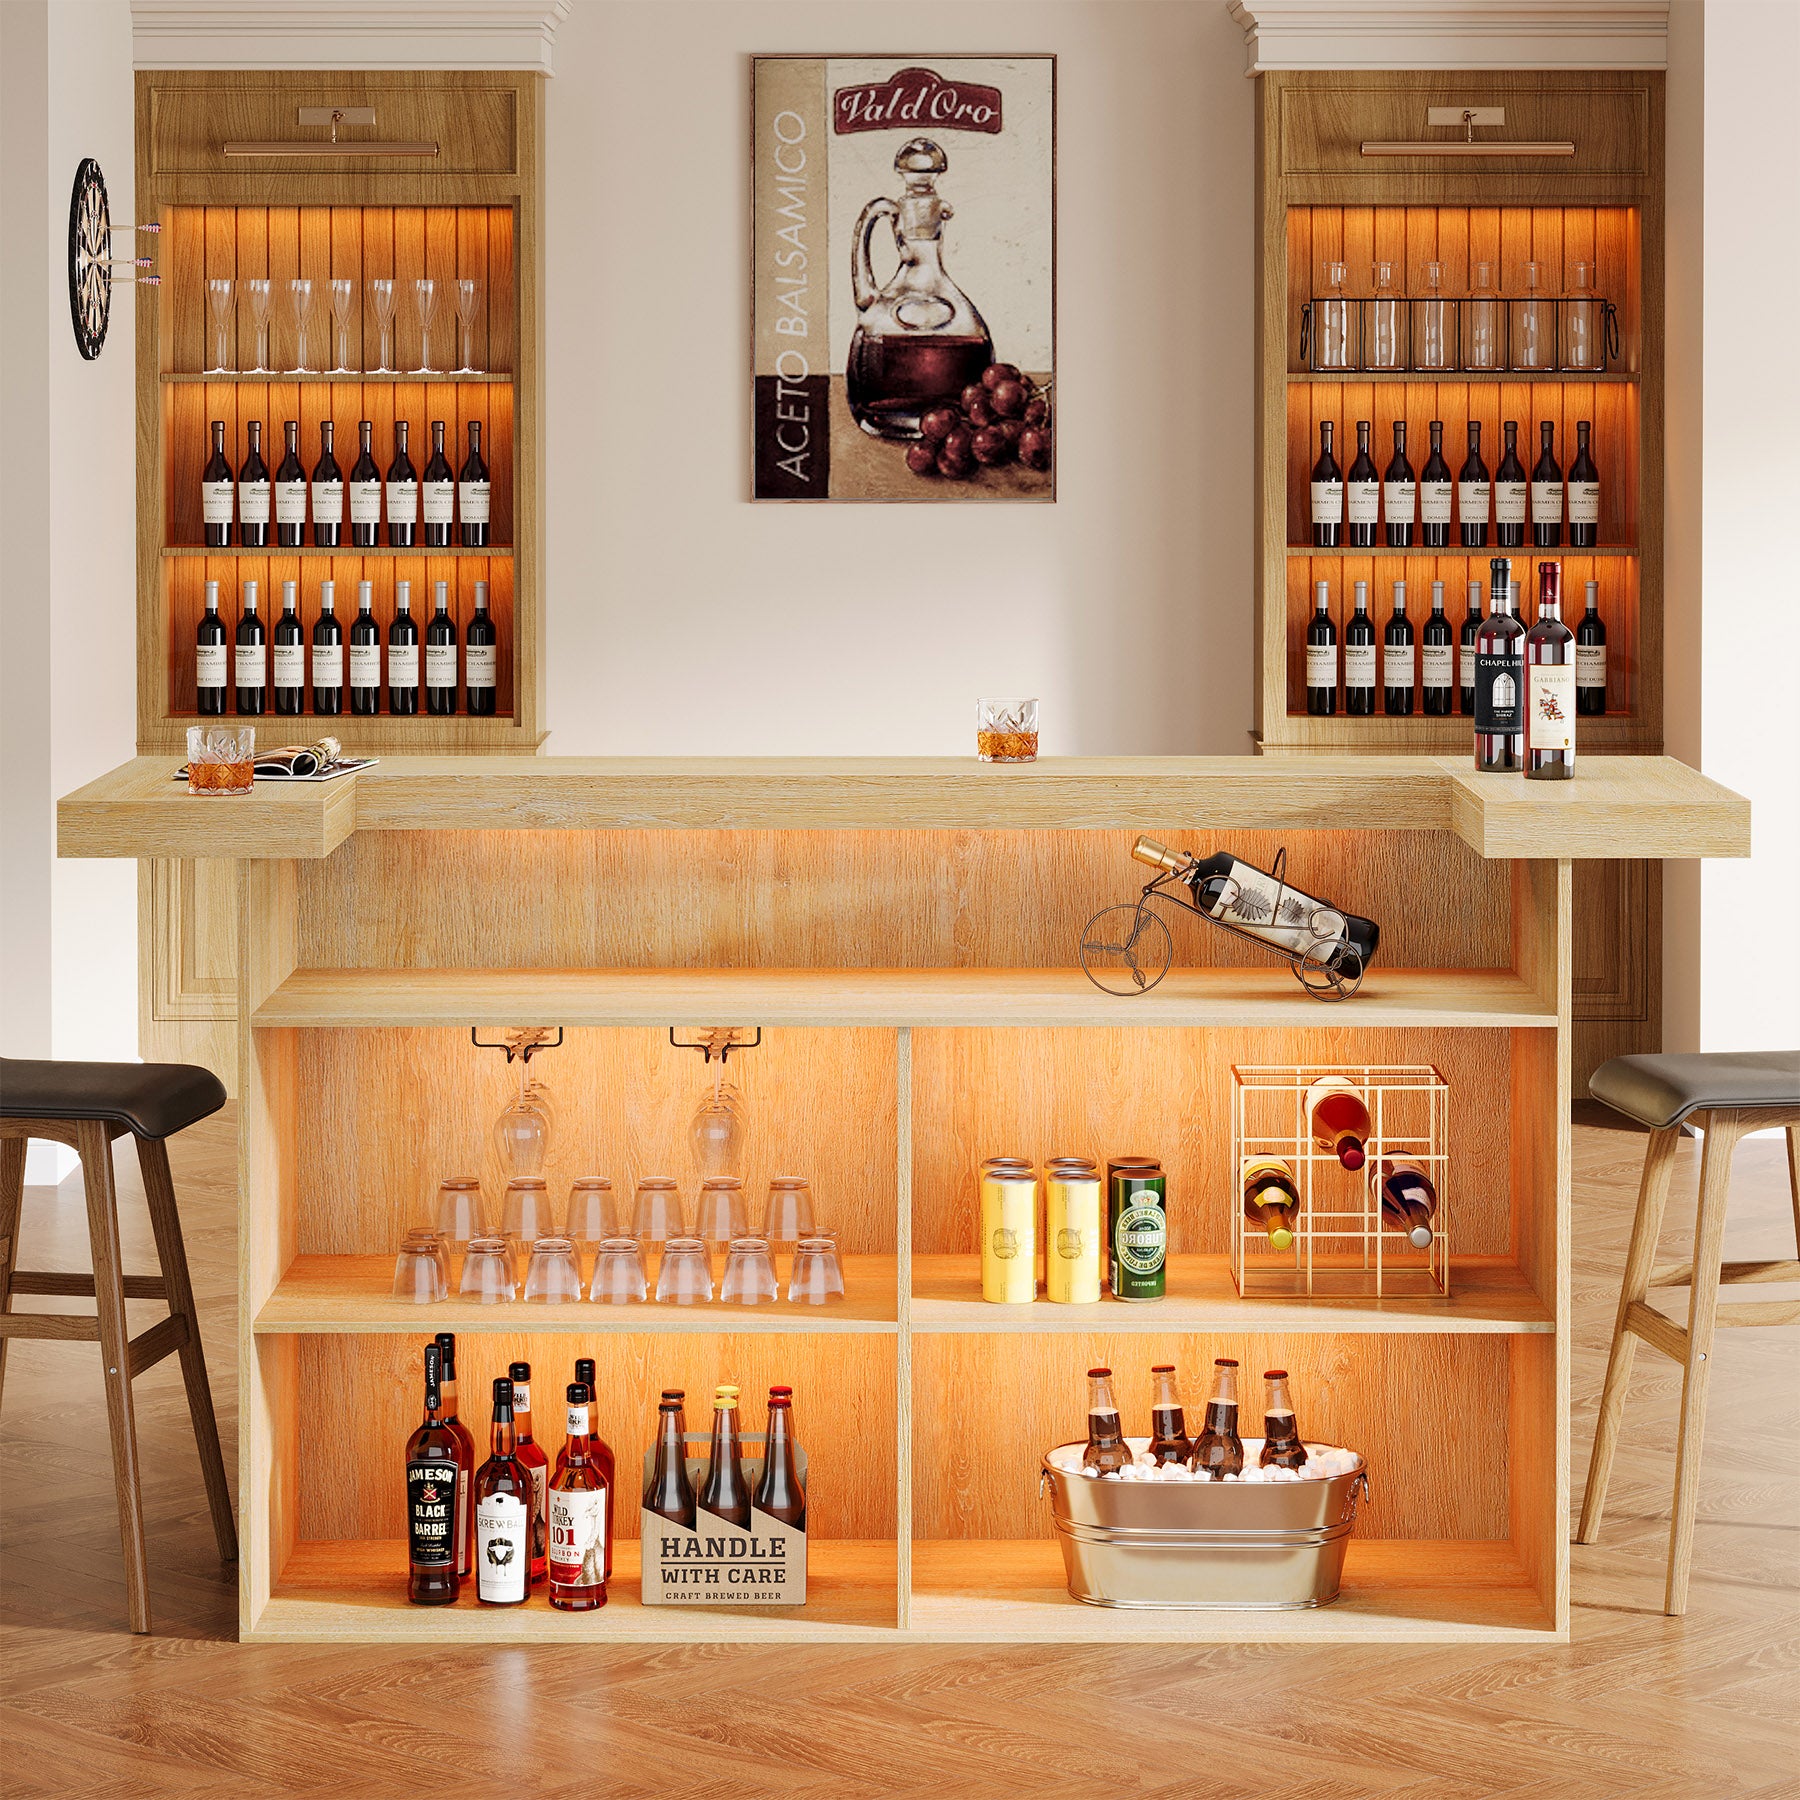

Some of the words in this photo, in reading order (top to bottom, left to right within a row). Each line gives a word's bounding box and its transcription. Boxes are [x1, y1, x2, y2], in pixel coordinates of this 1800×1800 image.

[773, 111, 809, 339] BALSAMICO
[776, 350, 809, 482] ACETO
[1480, 659, 1511, 667] CHAPEL
[409, 1468, 454, 1483] JAMESON
[415, 1504, 446, 1518] BLACK
[553, 1504, 568, 1516] WILD
[552, 1512, 574, 1526] TURKEY
[415, 1522, 447, 1536] BARREL
[552, 1526, 576, 1546] 101
[660, 1537, 786, 1558] HANDLE
[661, 1568, 720, 1584] WITH
[727, 1568, 786, 1584] CARE
[665, 1592, 701, 1600] CRAFT
[705, 1592, 750, 1600] BREWED
[754, 1592, 782, 1600] BEER
